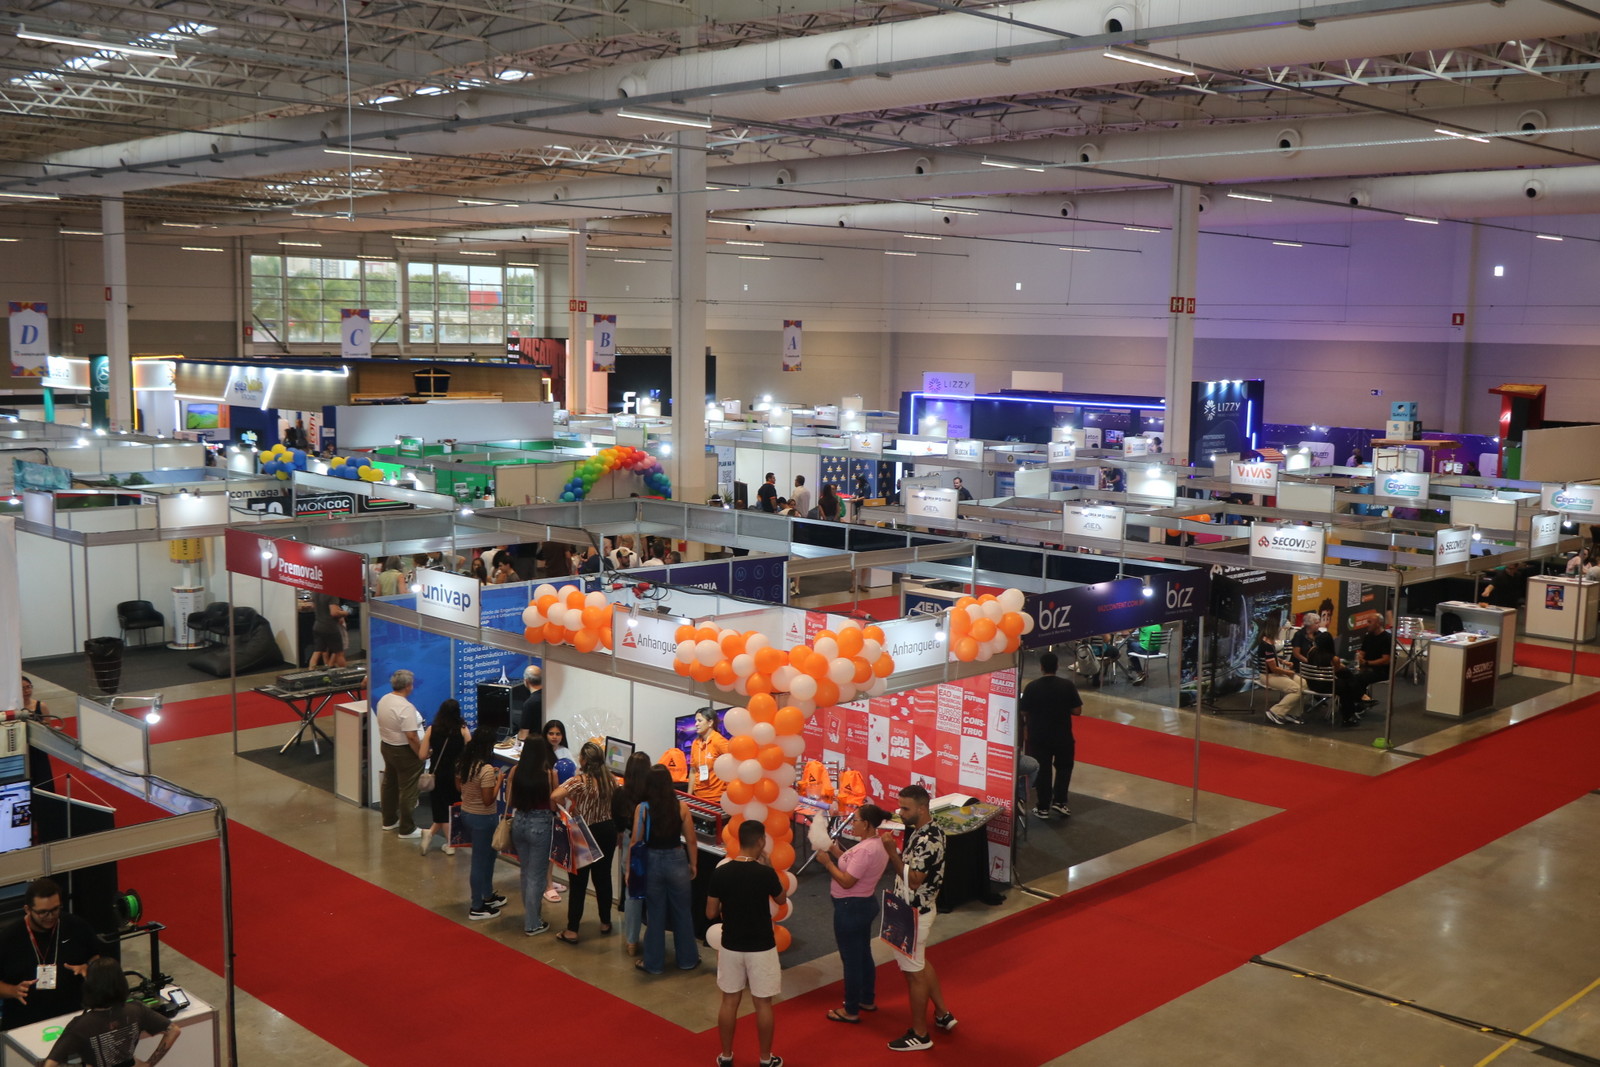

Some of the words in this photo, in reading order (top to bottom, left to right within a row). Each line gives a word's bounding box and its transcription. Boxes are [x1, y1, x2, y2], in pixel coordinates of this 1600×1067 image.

[20, 324, 38, 345] D
[350, 328, 363, 346] C
[600, 332, 611, 348] B
[788, 336, 797, 350] A
[944, 380, 970, 389] LIZZY
[1218, 402, 1240, 412] LIZZY
[230, 490, 252, 498] com
[254, 489, 279, 497] vaga
[1388, 482, 1420, 493] Cephas
[298, 500, 350, 512] MONCOC
[1556, 496, 1594, 506] Cephas
[279, 558, 324, 581] Premovale
[421, 584, 471, 612] univap
[1166, 581, 1194, 609] brz
[1038, 600, 1072, 630] brz
[637, 634, 676, 653] Anhangue
[893, 640, 941, 656] Anhanguera
[475, 651, 503, 660] Aeronáutica
[475, 659, 500, 668] Ambiental
[475, 668, 500, 676] Biomédica
[939, 689, 952, 697] EAD
[963, 726, 983, 736] TRUO
[937, 750, 959, 760] próximo
[986, 796, 1011, 808] SONHE
